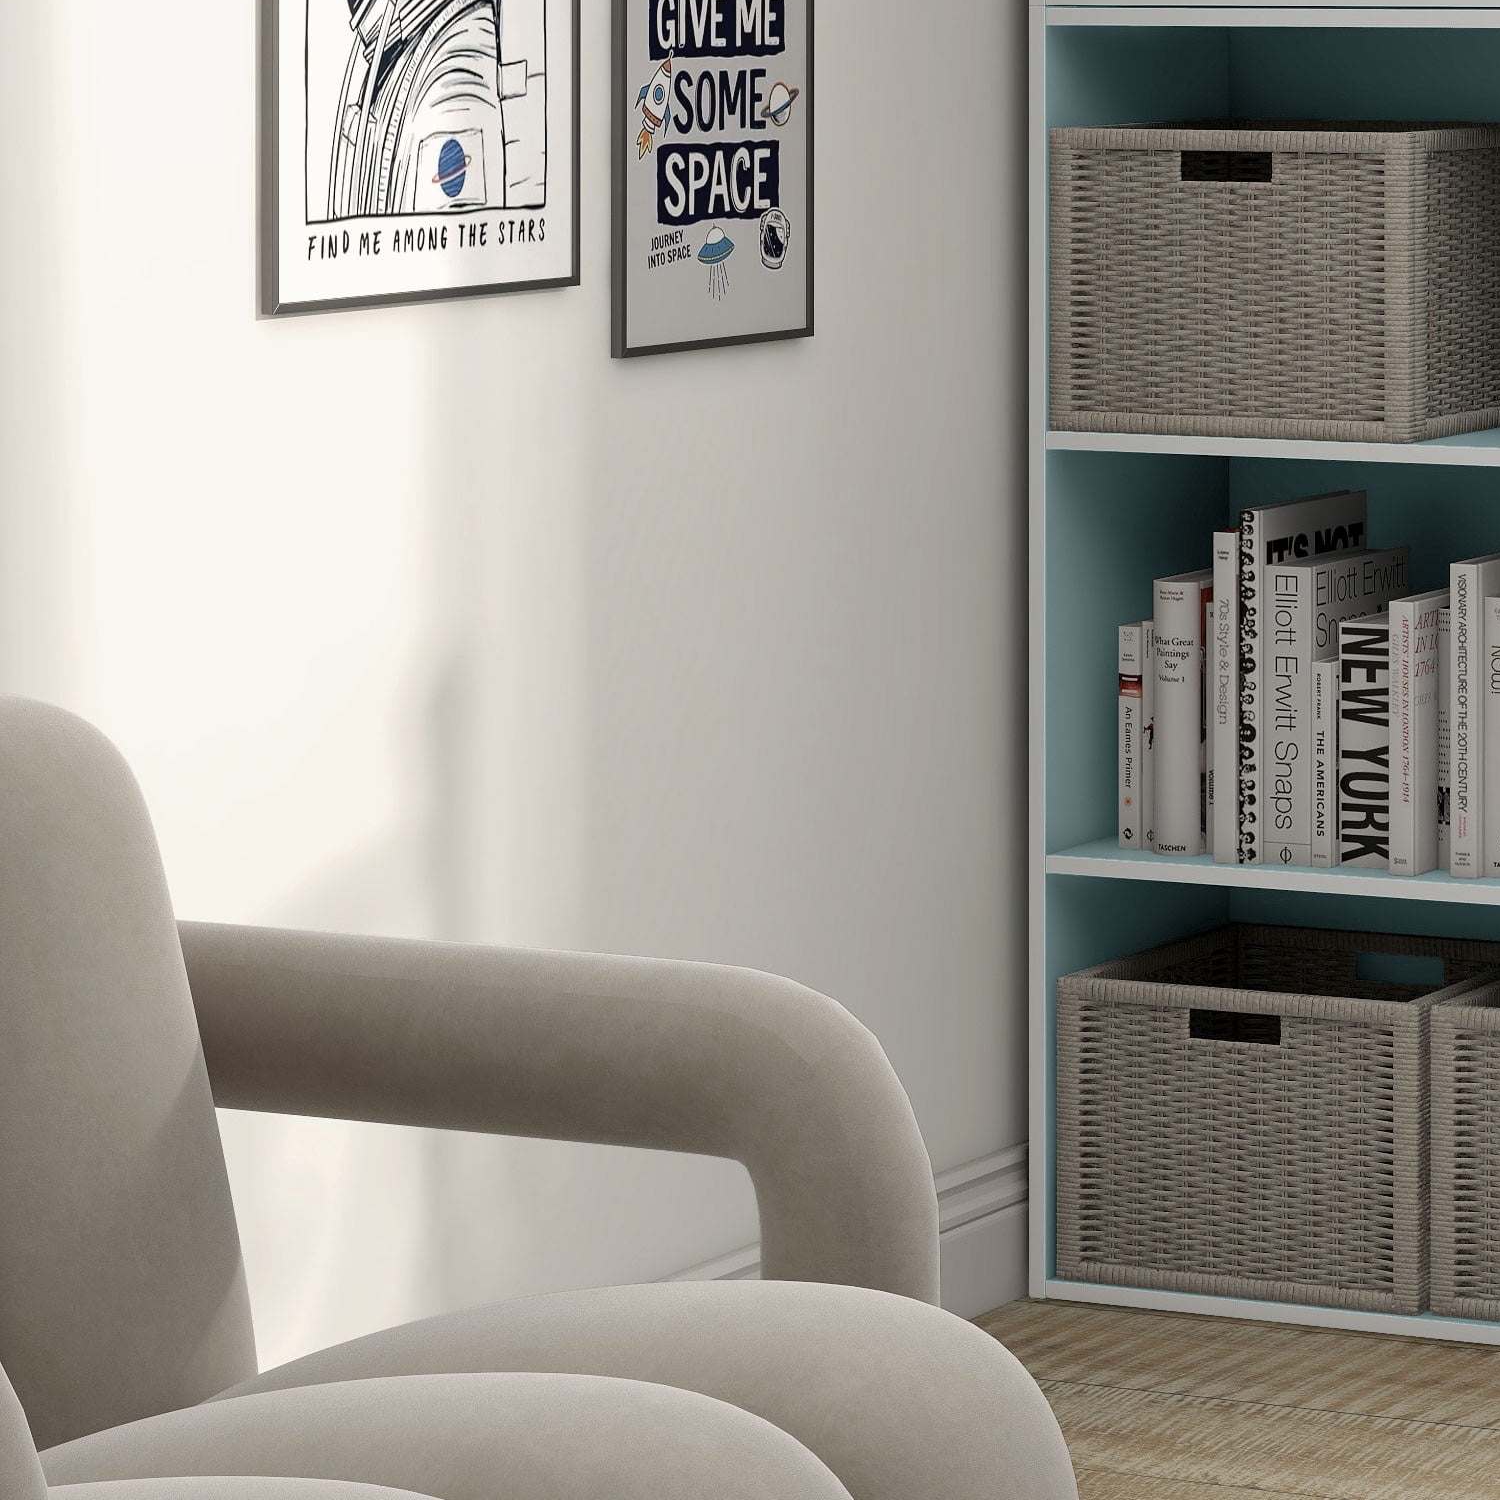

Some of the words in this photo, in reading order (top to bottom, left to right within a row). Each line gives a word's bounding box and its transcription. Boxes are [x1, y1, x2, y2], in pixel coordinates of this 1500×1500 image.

[672, 66, 766, 133] SOME
[663, 146, 770, 215] SPACE
[308, 227, 350, 261] FIND
[359, 229, 382, 255] ME
[392, 224, 449, 253] AMONG
[458, 222, 486, 248] THE
[498, 217, 546, 243] STARS
[651, 229, 684, 251] JOURNEY
[648, 252, 666, 269] INTO
[667, 244, 691, 263] SPACE
[1315, 522, 1364, 555] NOT
[1316, 567, 1357, 606] Elliott
[1363, 555, 1406, 596] Erwitt
[1219, 598, 1229, 621] 70s
[1275, 575, 1298, 646] Elliott
[1457, 574, 1467, 620] VISIONARY
[1156, 648, 1190, 659] Paintings
[1171, 637, 1194, 646] Great
[1216, 623, 1229, 657] Style
[1414, 636, 1428, 653] IN
[1164, 661, 1178, 671] Say
[1218, 660, 1229, 671] &
[1457, 621, 1467, 694] ARCHITECTURE
[1159, 674, 1180, 682] Volume
[1341, 627, 1389, 726] NEW
[1216, 675, 1229, 725] Design
[1275, 656, 1298, 732] Erwitt
[1402, 699, 1409, 711] IN
[1457, 695, 1467, 710] OF
[1124, 706, 1133, 719] An
[1457, 711, 1467, 731] THE
[1124, 722, 1133, 754] Eames
[1317, 731, 1325, 755] THE
[1457, 732, 1467, 761] 20TH
[1124, 757, 1133, 788] Primer
[1270, 741, 1299, 830] Snaps
[1457, 762, 1467, 813] CENTURY
[1317, 760, 1325, 837] AMERICANS
[1340, 746, 1389, 863] YORK
